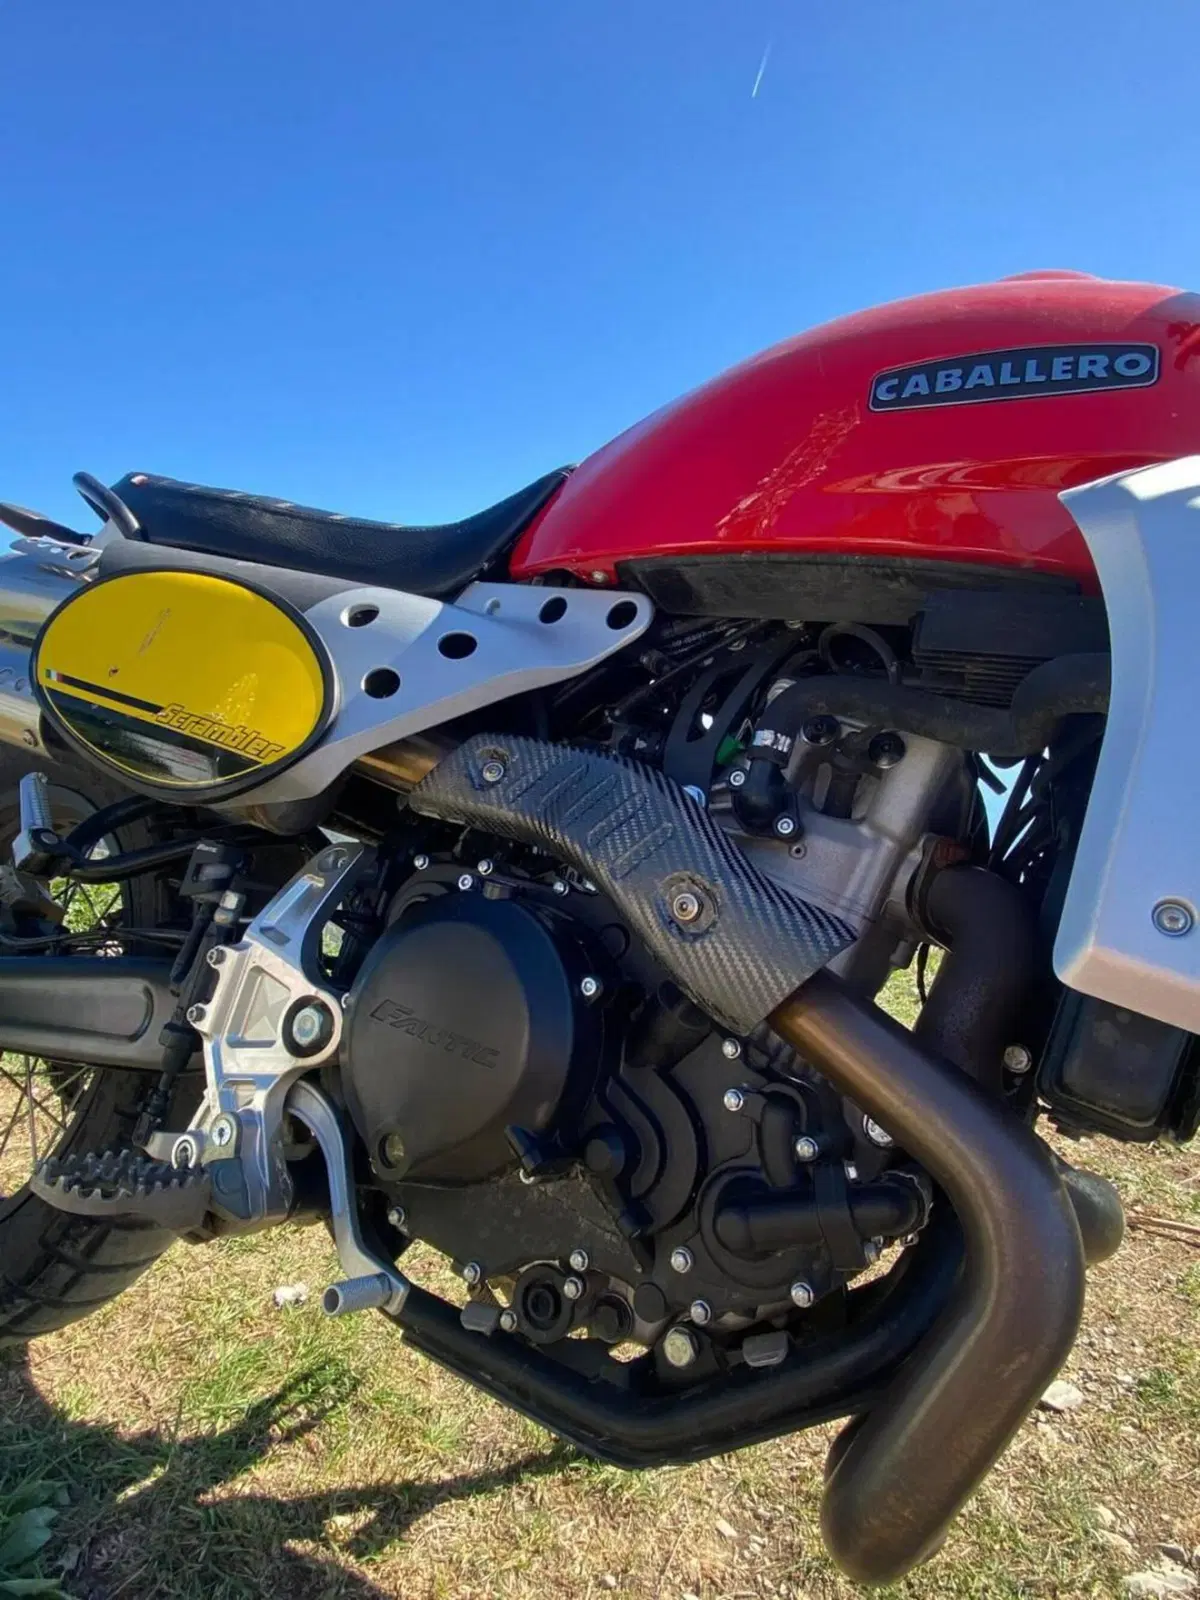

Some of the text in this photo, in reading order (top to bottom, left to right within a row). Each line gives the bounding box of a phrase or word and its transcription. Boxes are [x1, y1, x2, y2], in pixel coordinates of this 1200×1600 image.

[875, 353, 1151, 401] CABALLERO
[156, 703, 286, 760] Scrambler
[369, 998, 501, 1069] FANTIC
